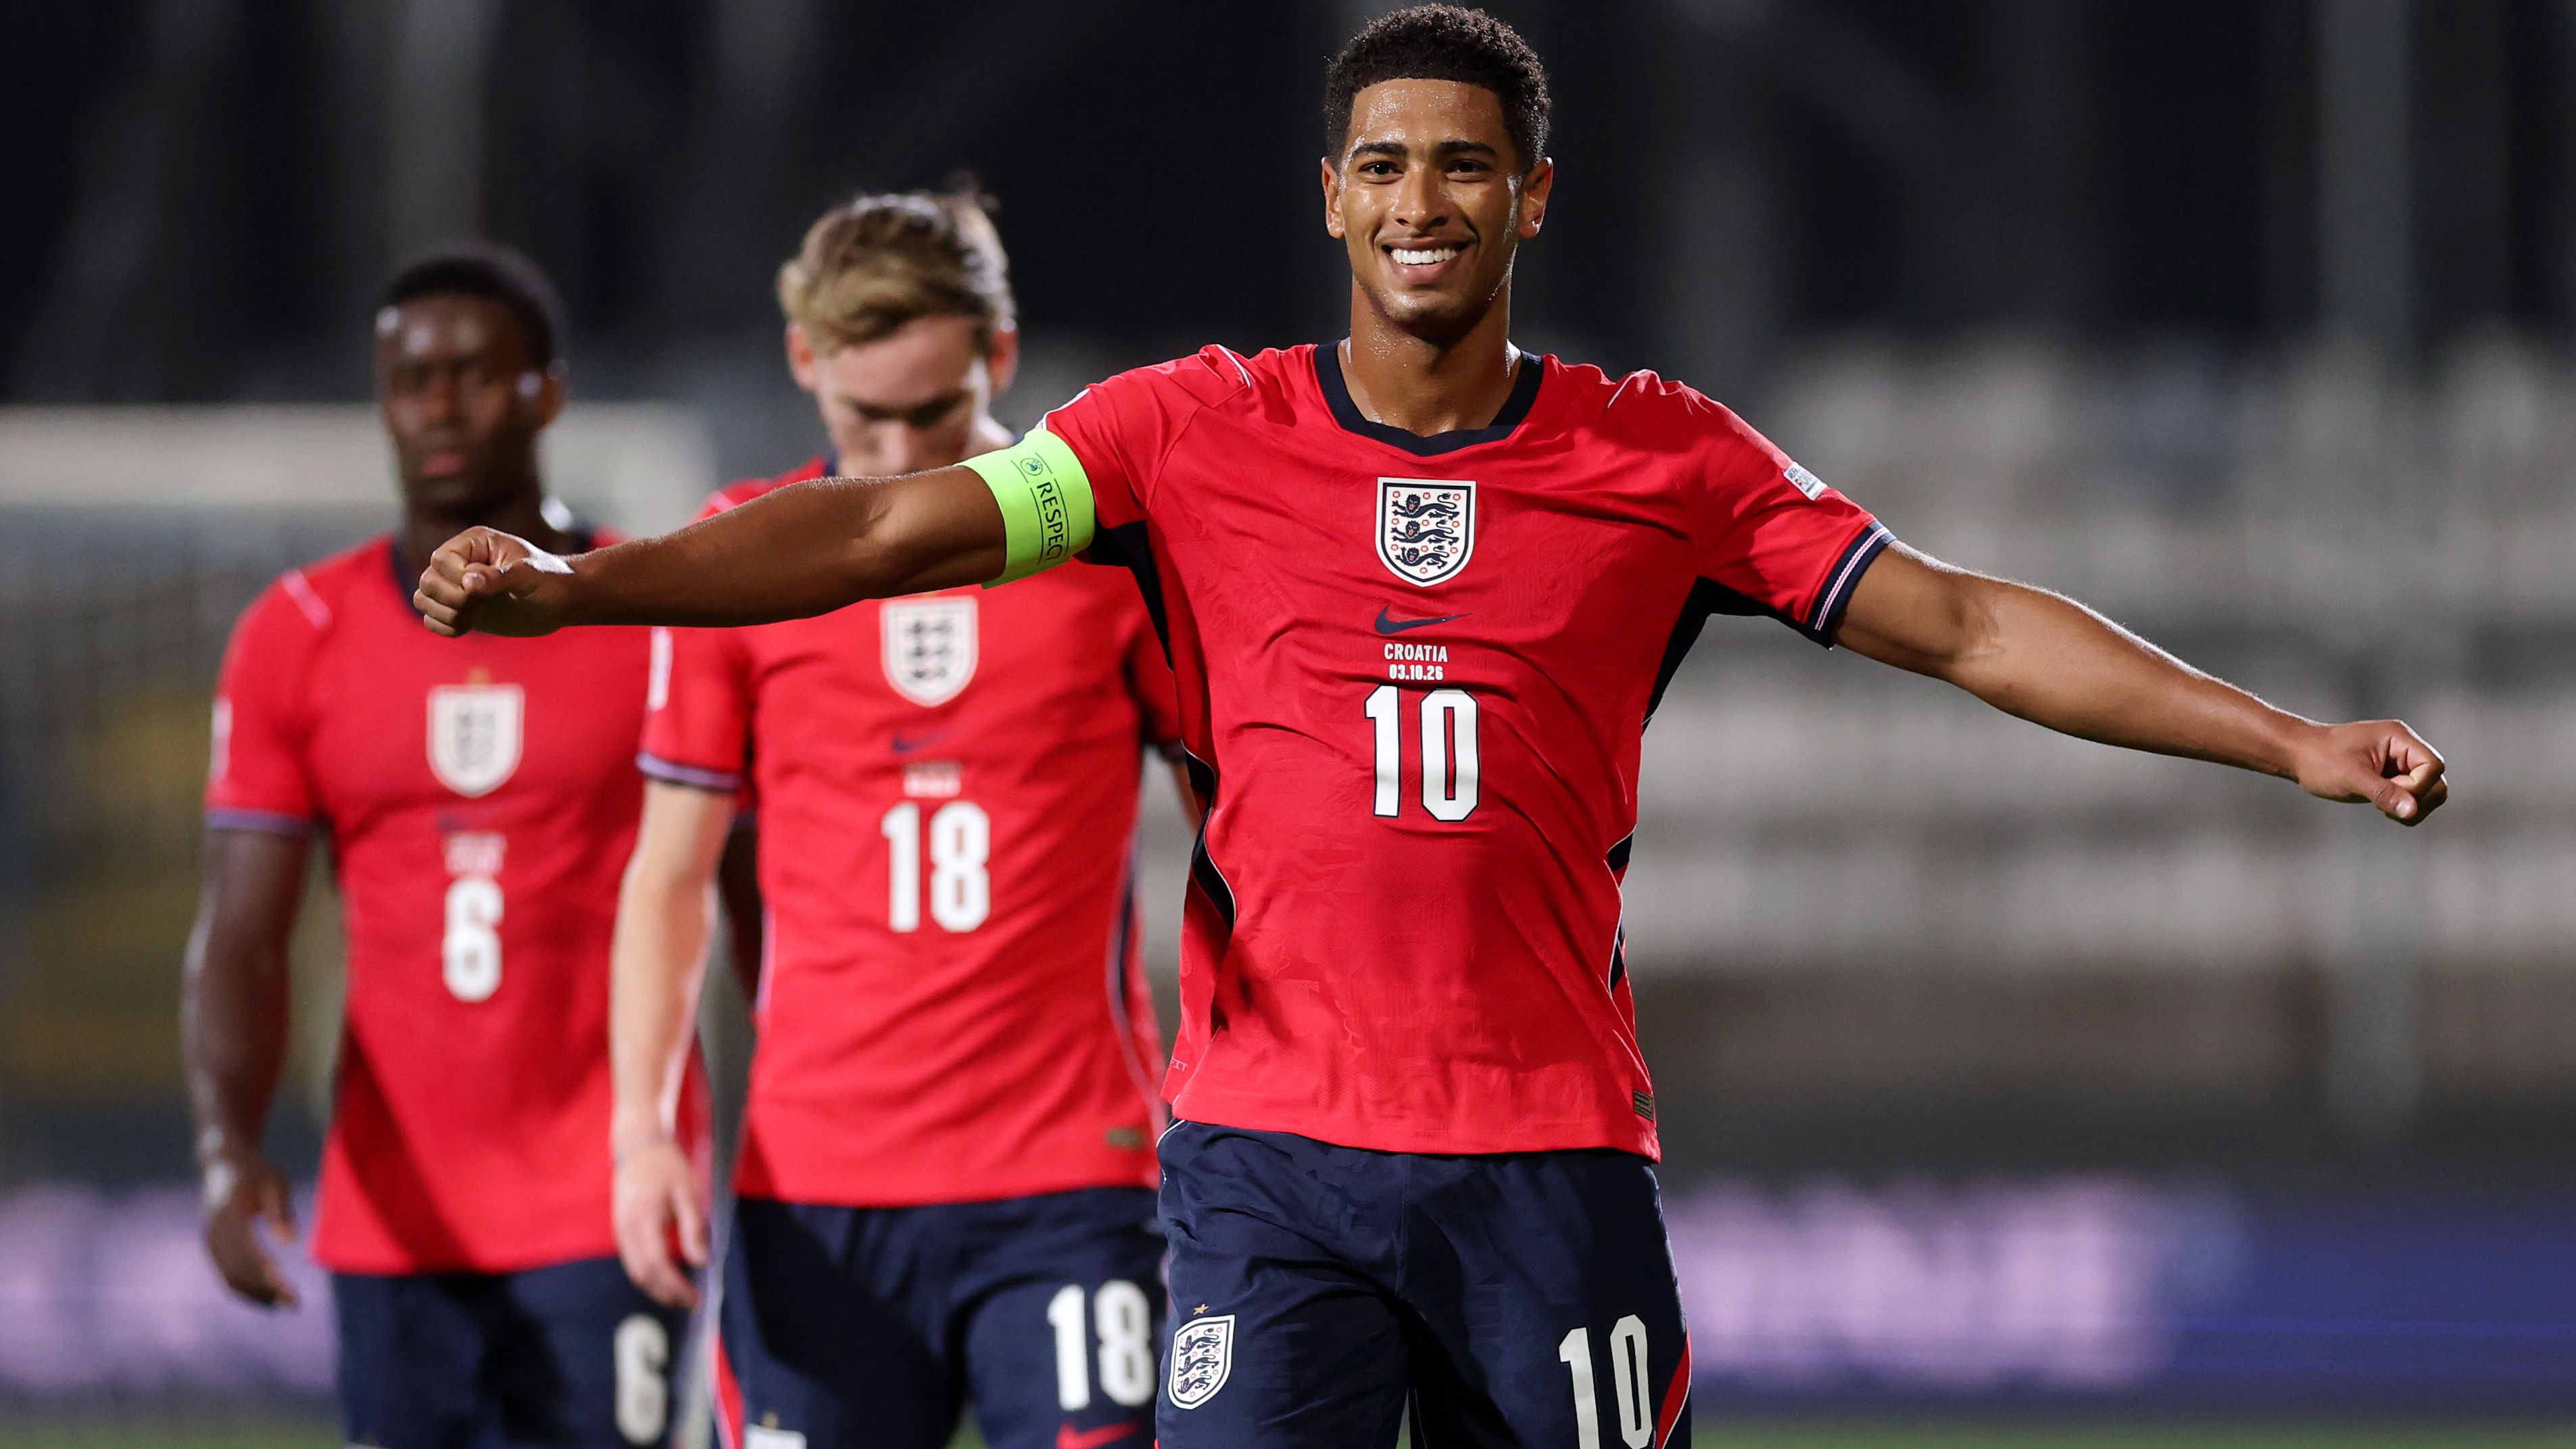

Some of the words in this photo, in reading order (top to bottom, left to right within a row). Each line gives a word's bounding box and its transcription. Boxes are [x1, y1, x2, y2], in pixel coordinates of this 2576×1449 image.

[1384, 643, 1448, 662] CROATIA
[1389, 664, 1444, 681] 03.10.26
[1364, 684, 1480, 822] 10
[881, 800, 992, 933] 18
[443, 877, 505, 1004] 6
[613, 1312, 669, 1446] 6
[1047, 1279, 1155, 1413] 18
[1559, 1314, 1653, 1449] 10
